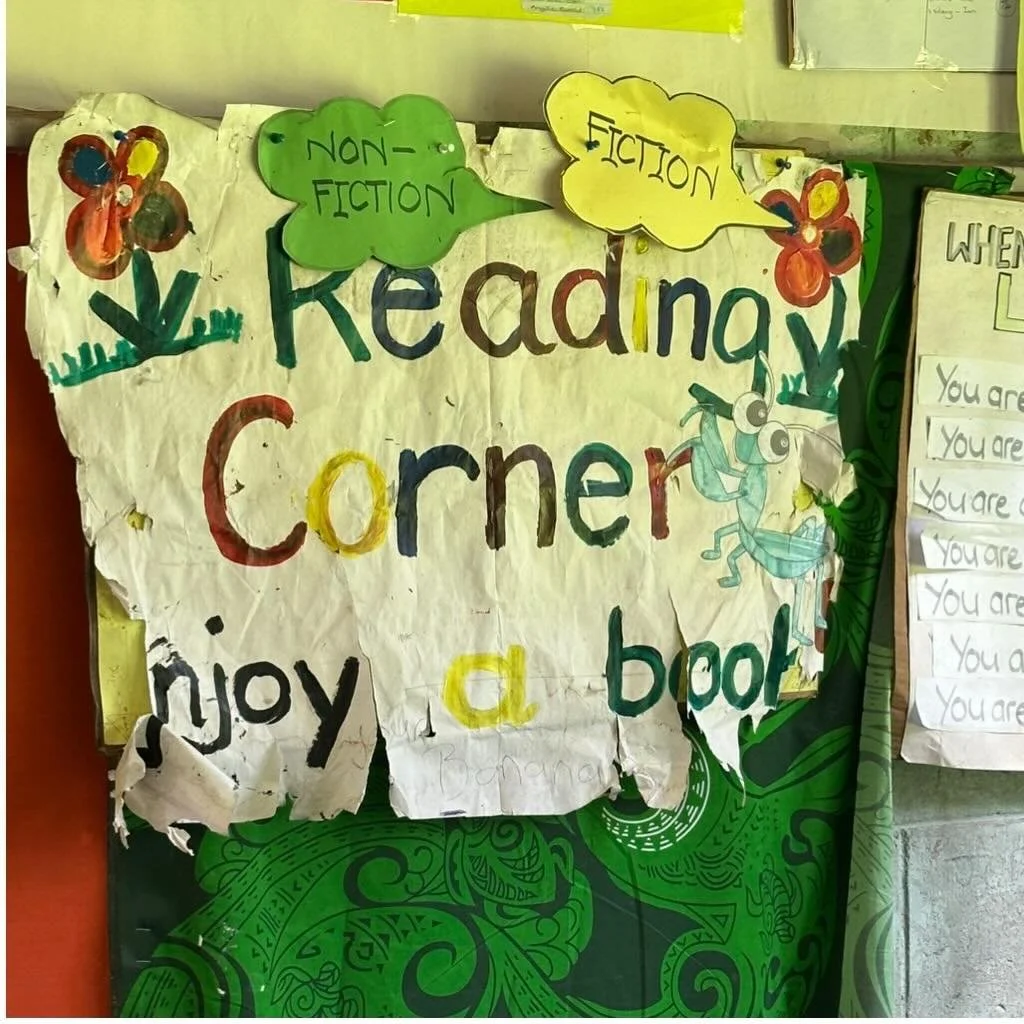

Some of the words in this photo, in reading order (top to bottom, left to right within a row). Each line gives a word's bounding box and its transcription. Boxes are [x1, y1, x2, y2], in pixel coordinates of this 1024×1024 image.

[307, 130, 416, 168] NON-
[587, 110, 721, 201] FICTION
[312, 177, 456, 219] FICTION
[266, 212, 773, 402] Reading
[936, 362, 980, 404] You
[941, 424, 985, 460] You
[992, 434, 1024, 463] are
[201, 394, 693, 568] Corner
[919, 477, 966, 512] You
[971, 489, 1011, 519] are
[934, 533, 979, 567] You
[983, 543, 1023, 570] are
[925, 578, 979, 617] You
[950, 633, 1000, 674] You
[440, 644, 540, 730] a
[935, 684, 985, 726] You
